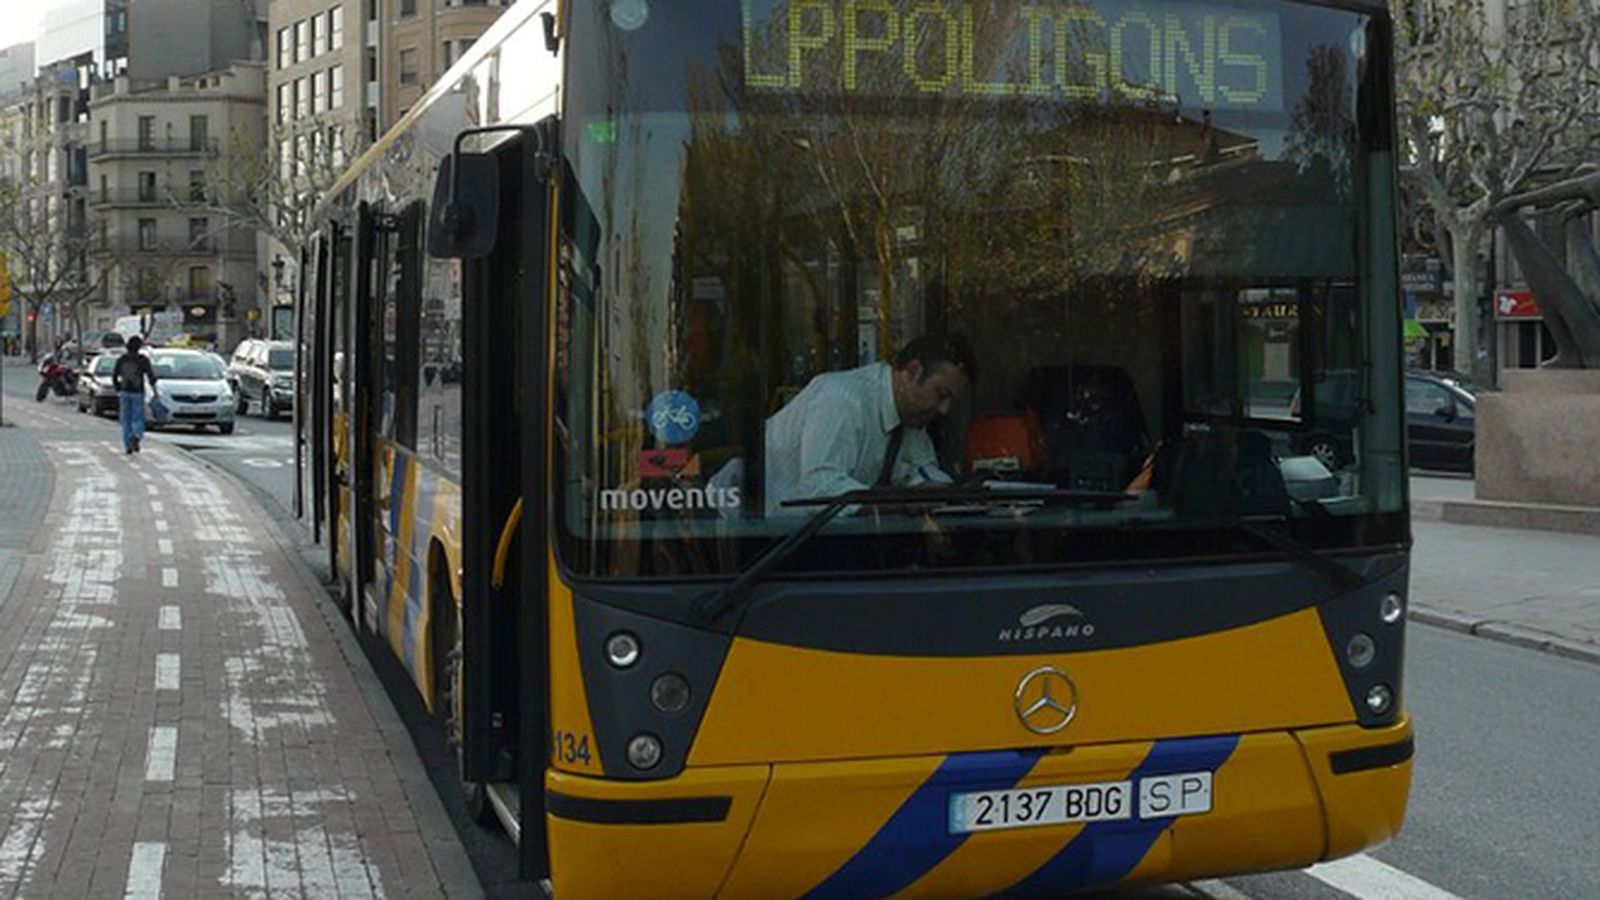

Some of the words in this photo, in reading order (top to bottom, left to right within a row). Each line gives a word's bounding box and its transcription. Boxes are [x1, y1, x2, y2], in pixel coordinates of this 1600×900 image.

[600, 482, 742, 510] moventis
[975, 790, 1053, 826] 2137
[1065, 786, 1122, 819] BDG
